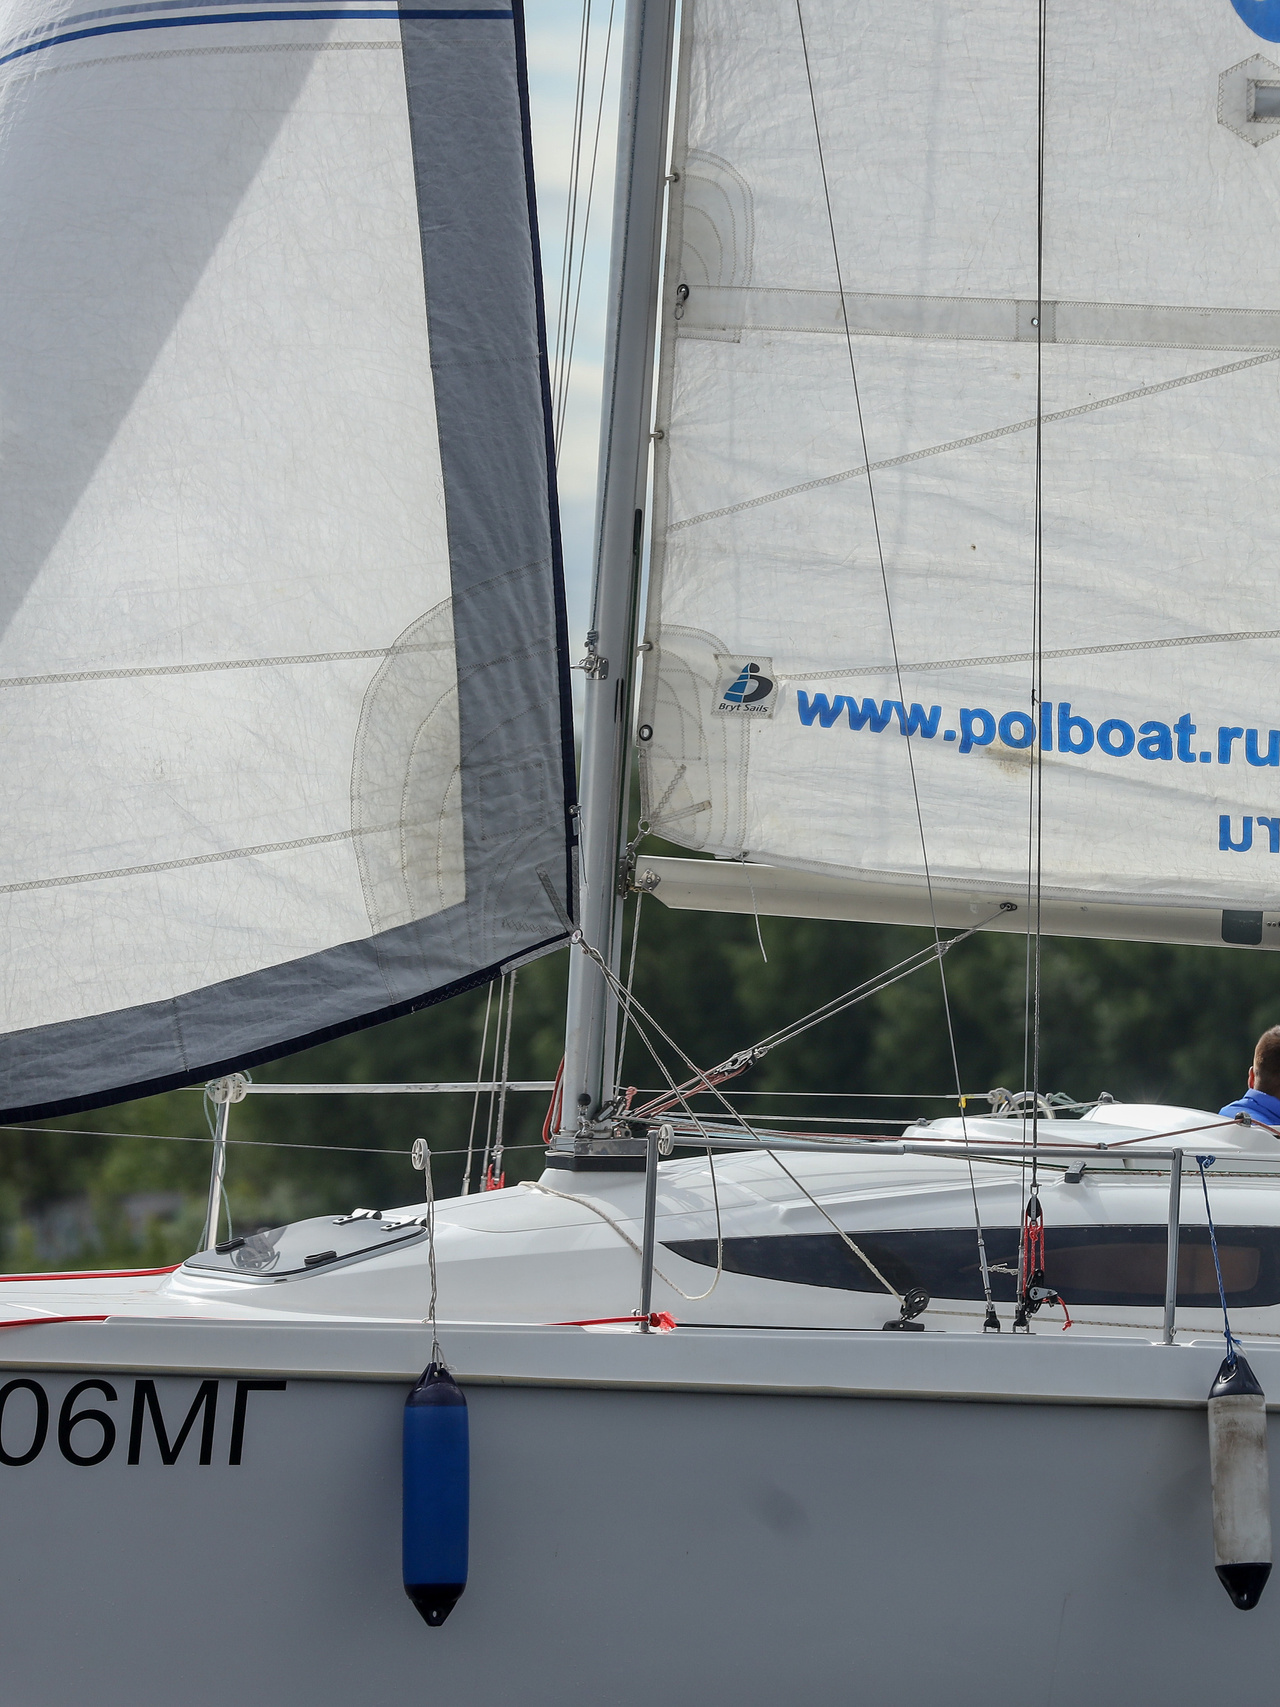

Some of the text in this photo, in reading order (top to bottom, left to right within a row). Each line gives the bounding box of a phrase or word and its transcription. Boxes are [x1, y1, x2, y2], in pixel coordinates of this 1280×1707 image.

[719, 702, 769, 712] Bryt Sails
[798, 690, 1280, 767] www.polboat.ru
